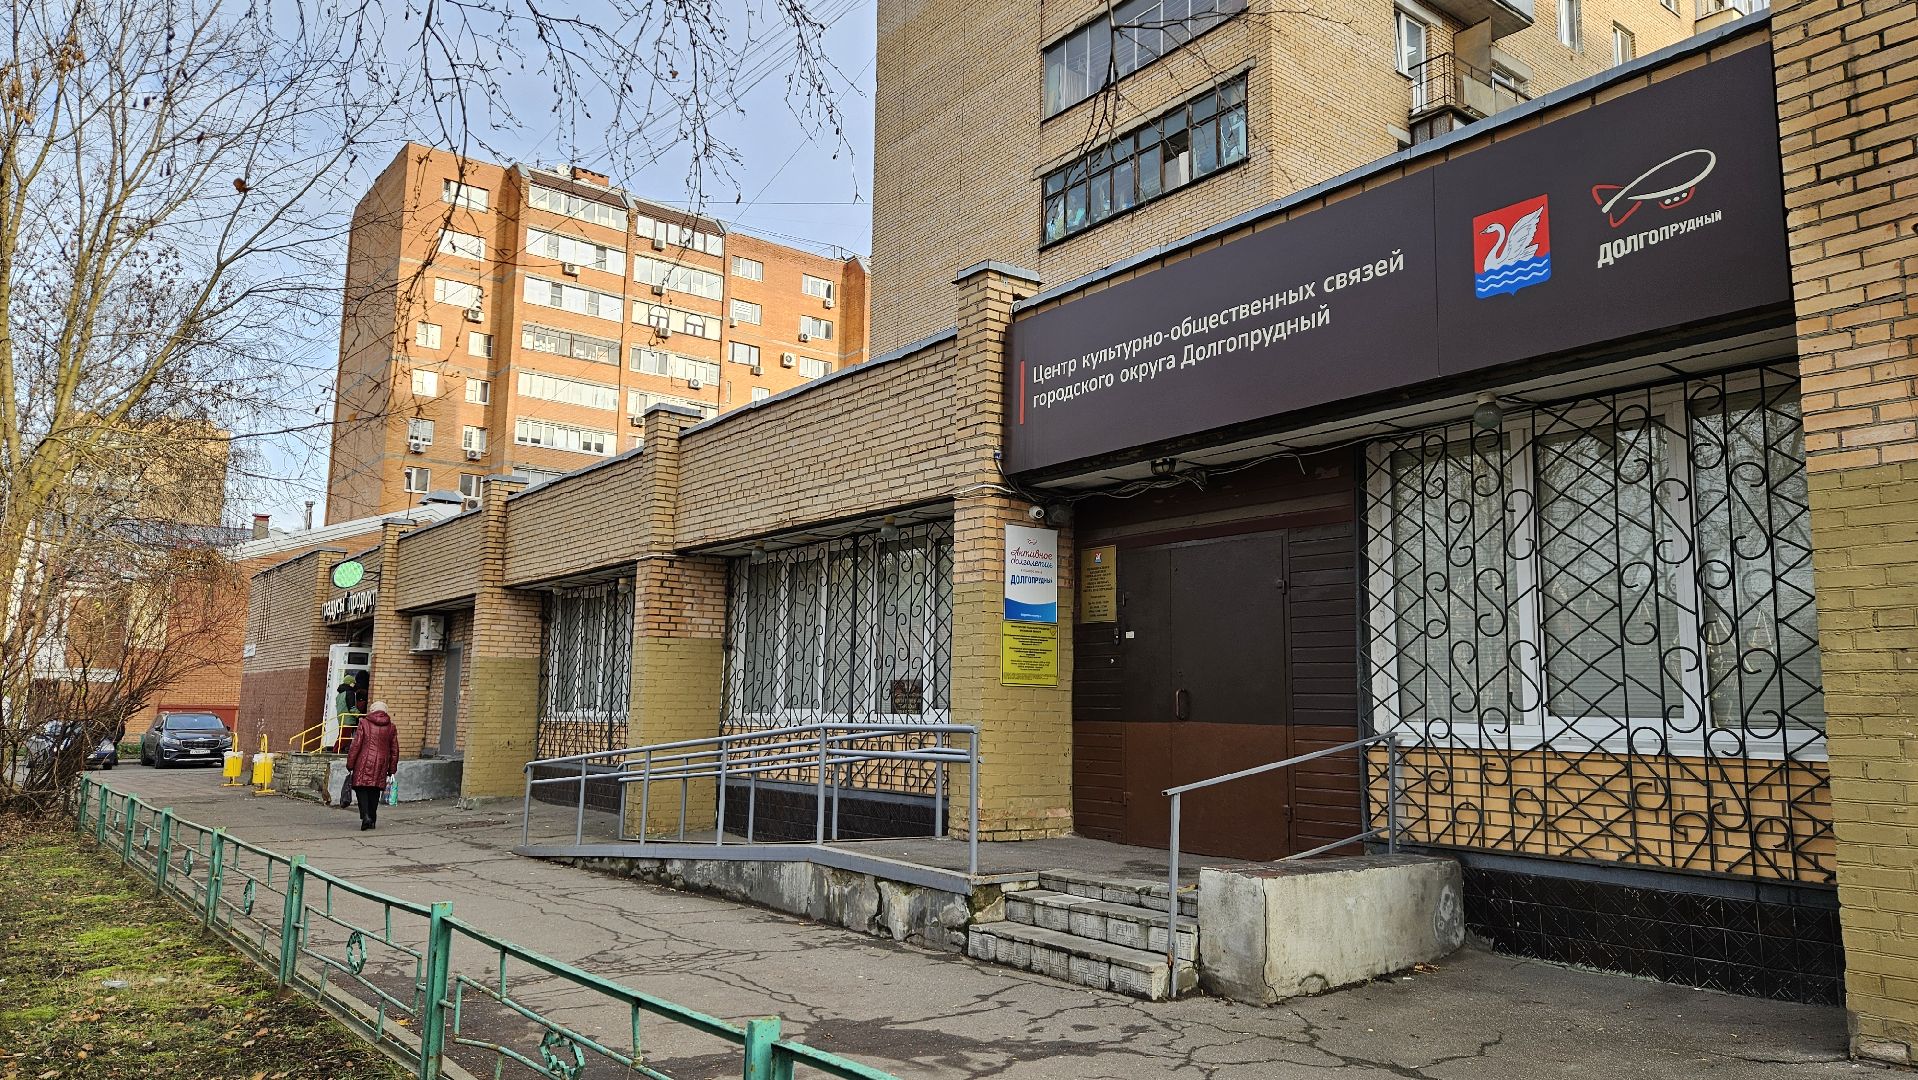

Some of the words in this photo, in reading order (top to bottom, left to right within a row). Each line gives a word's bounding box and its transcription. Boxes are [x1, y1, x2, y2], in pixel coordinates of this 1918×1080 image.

[1598, 209, 1721, 269] ДОЛГОПРУДНЫЙ
[1033, 359, 1076, 386] Центр
[1082, 282, 1316, 371] культурно-общественных
[1323, 249, 1404, 293] связей
[1033, 373, 1115, 409] городского
[1119, 354, 1176, 384] округа
[1181, 304, 1330, 370] Долгопрудный
[1010, 546, 1053, 561] Активное
